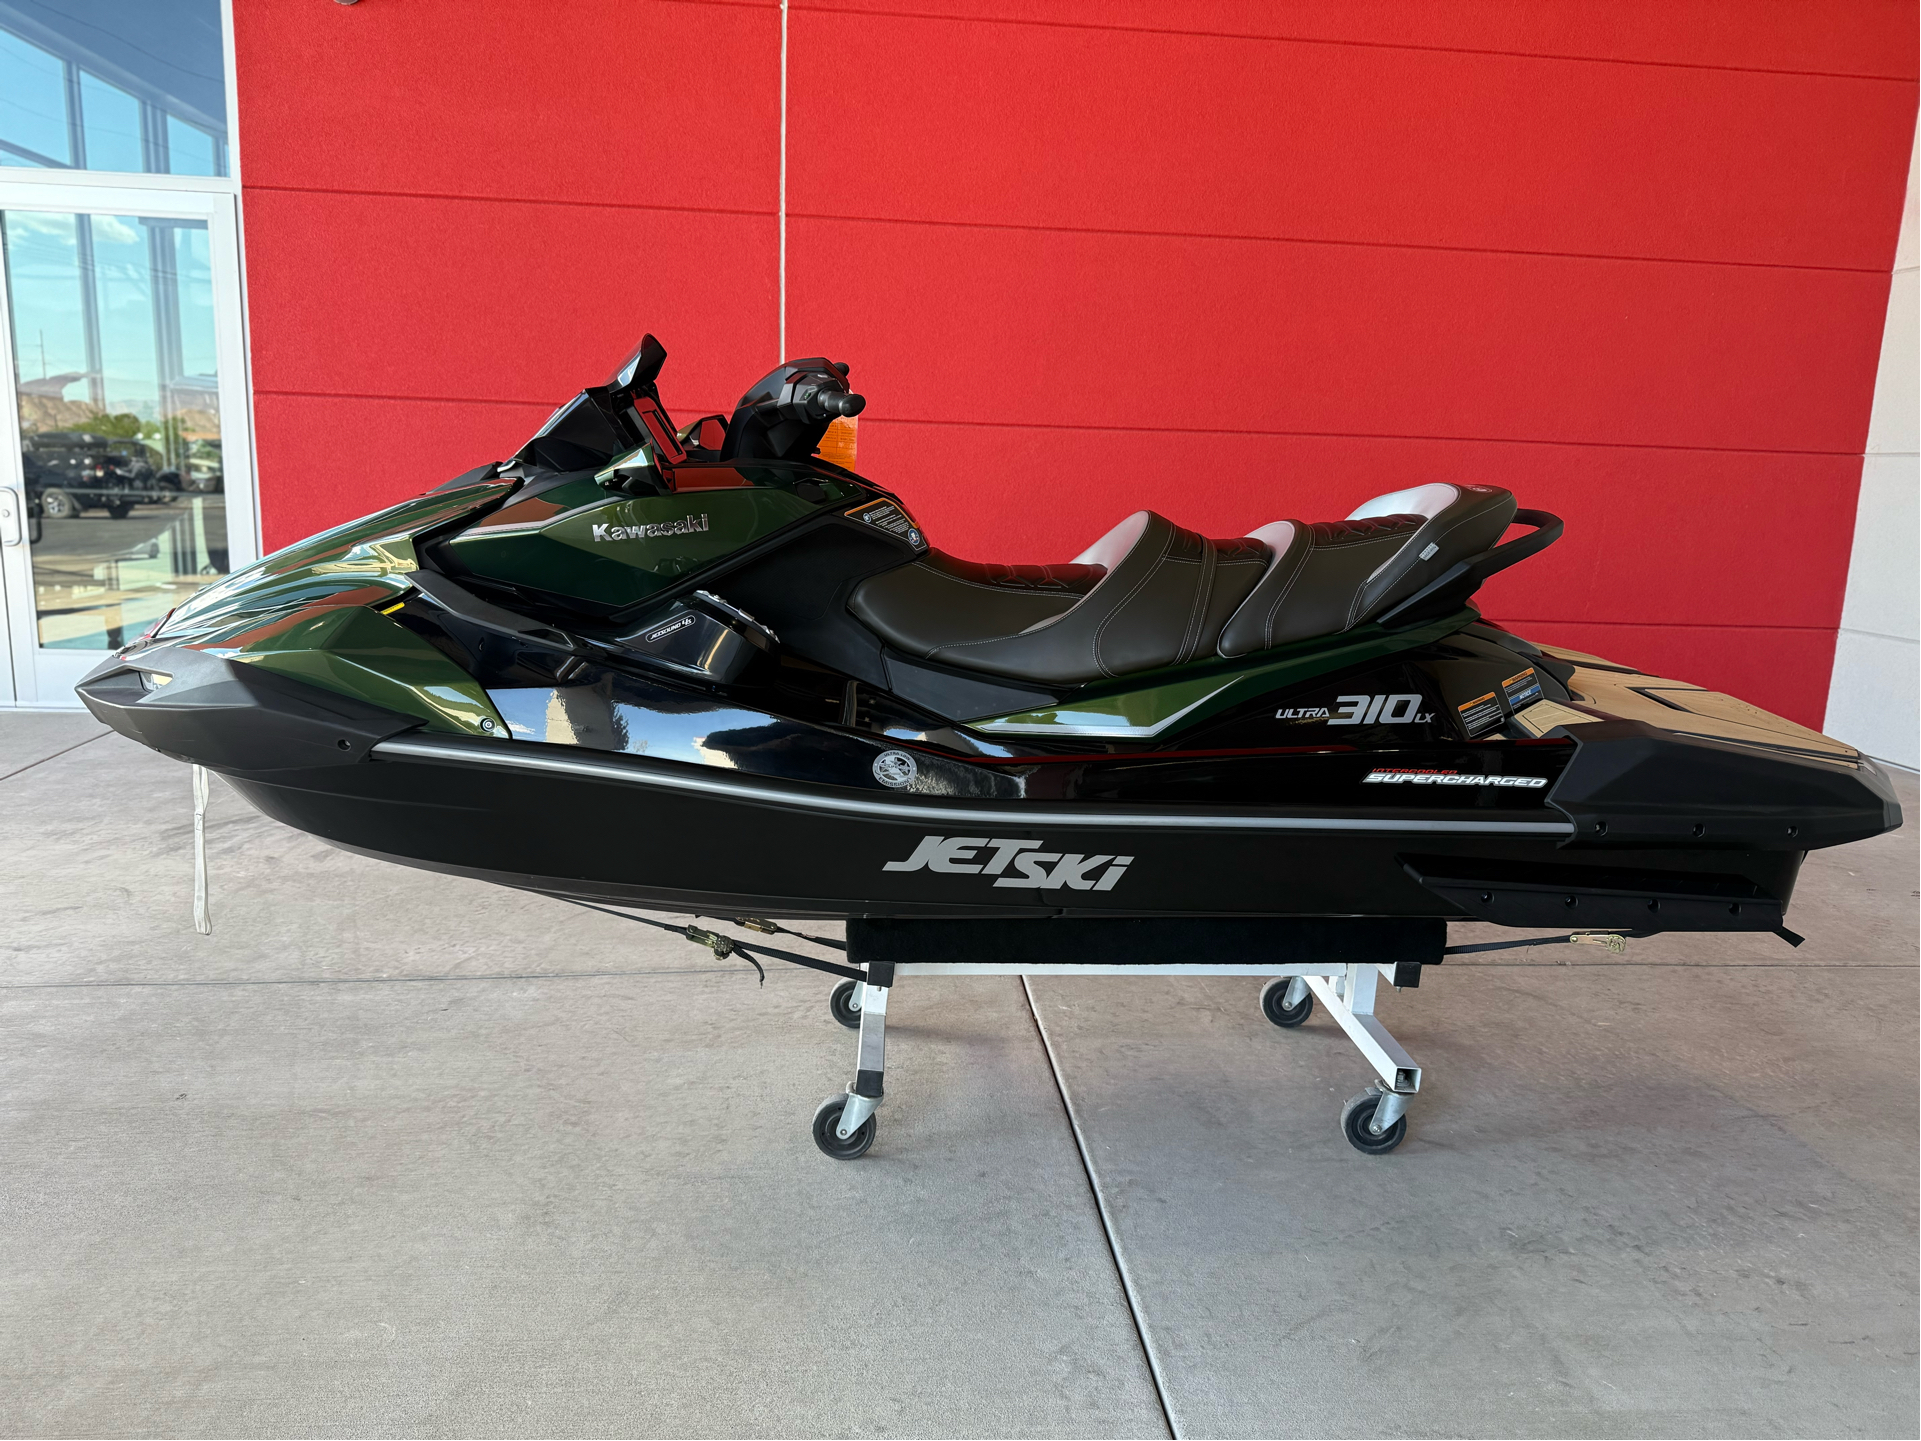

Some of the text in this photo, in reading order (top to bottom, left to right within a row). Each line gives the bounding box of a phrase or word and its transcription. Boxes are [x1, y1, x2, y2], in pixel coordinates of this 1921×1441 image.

[592, 513, 709, 542] Kawasaki
[1275, 694, 1435, 725] ULTRA 310 LX
[1363, 772, 1549, 789] SUPERCHARGED
[882, 836, 1044, 875] JET
